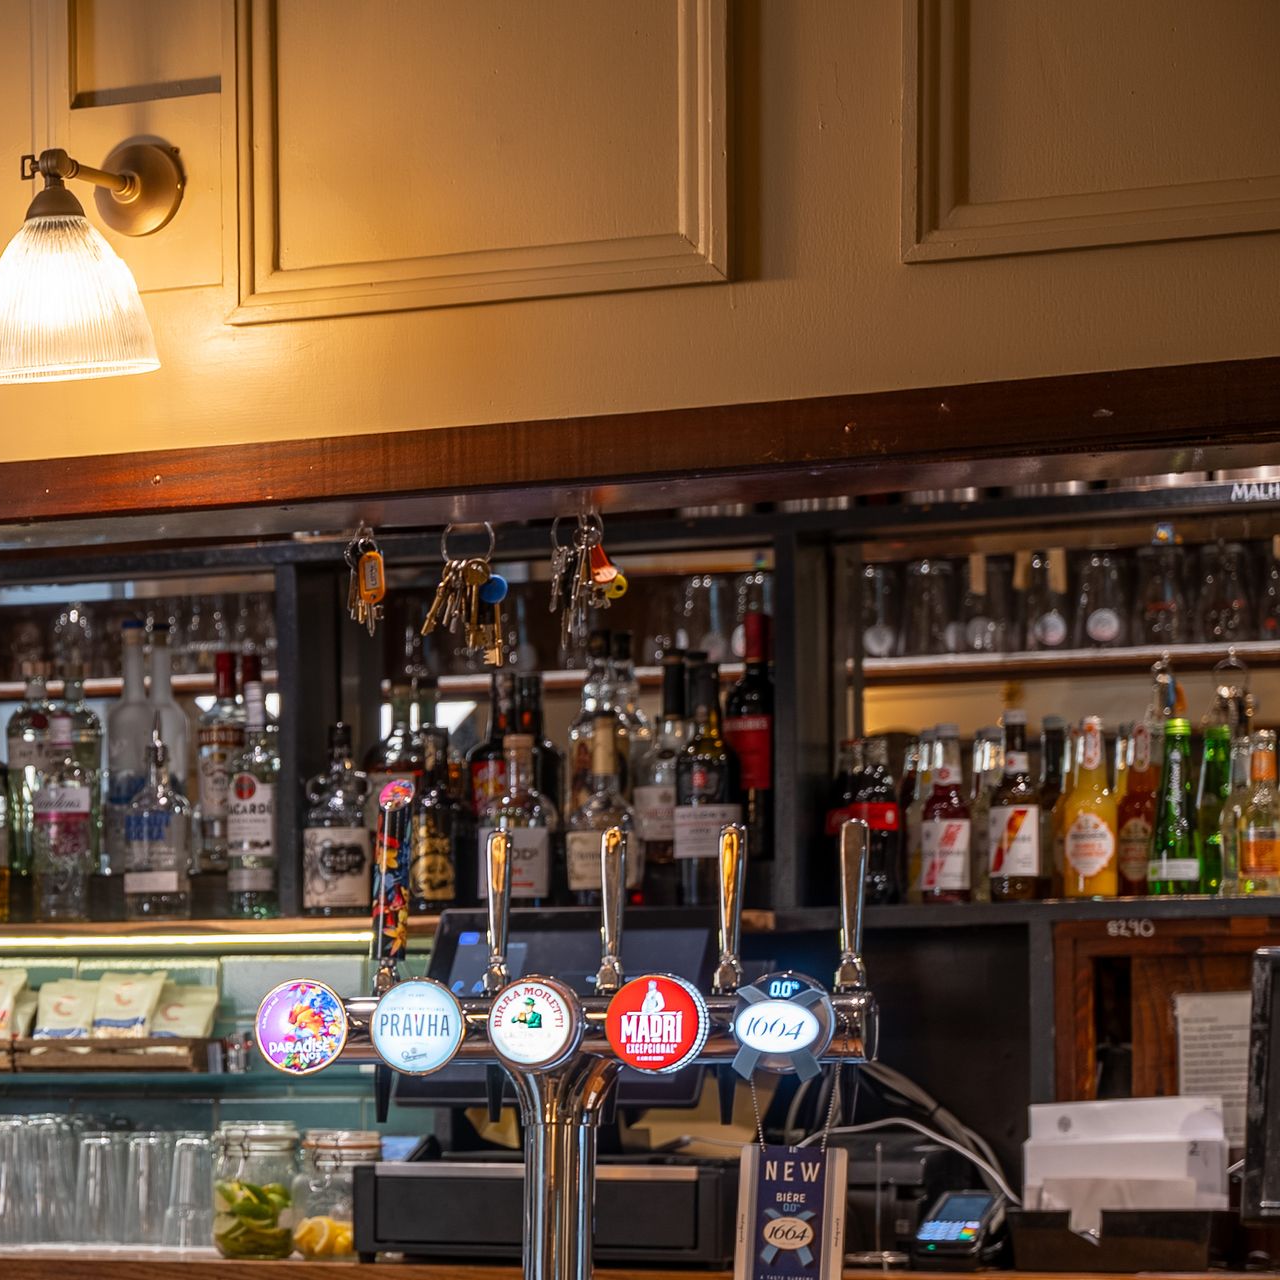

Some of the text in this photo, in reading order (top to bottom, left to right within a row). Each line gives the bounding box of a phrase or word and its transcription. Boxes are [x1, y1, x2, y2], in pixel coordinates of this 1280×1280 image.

[494, 987, 564, 1028] BIRRA MORETTI
[380, 1013, 450, 1037] PRAVHA
[746, 1016, 805, 1040] 1664
[765, 1160, 820, 1183] NEW
[768, 1224, 808, 1242] 1664
